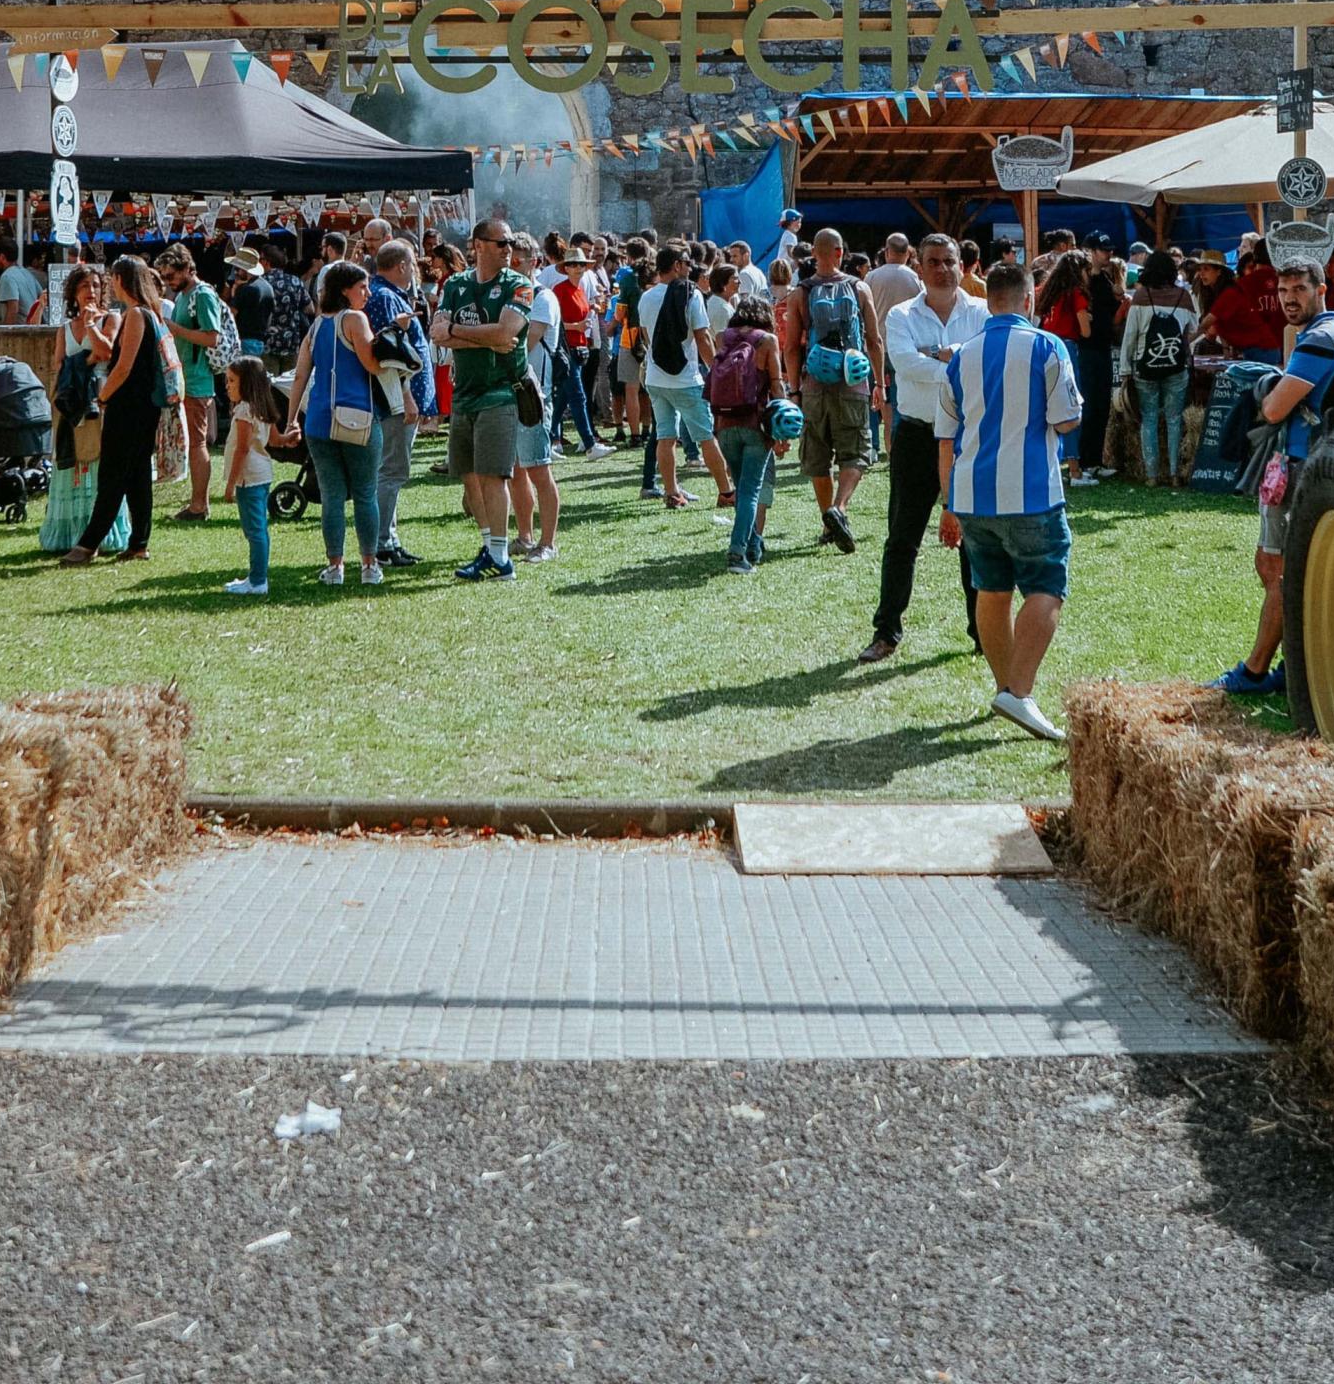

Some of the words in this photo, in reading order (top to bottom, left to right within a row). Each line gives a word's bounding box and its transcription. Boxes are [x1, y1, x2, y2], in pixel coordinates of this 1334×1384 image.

[338, 48, 405, 95] LA
[1004, 167, 1061, 177] MERCADO
[1011, 177, 1054, 187] COSECH
[1276, 248, 1325, 257] MERCADO
